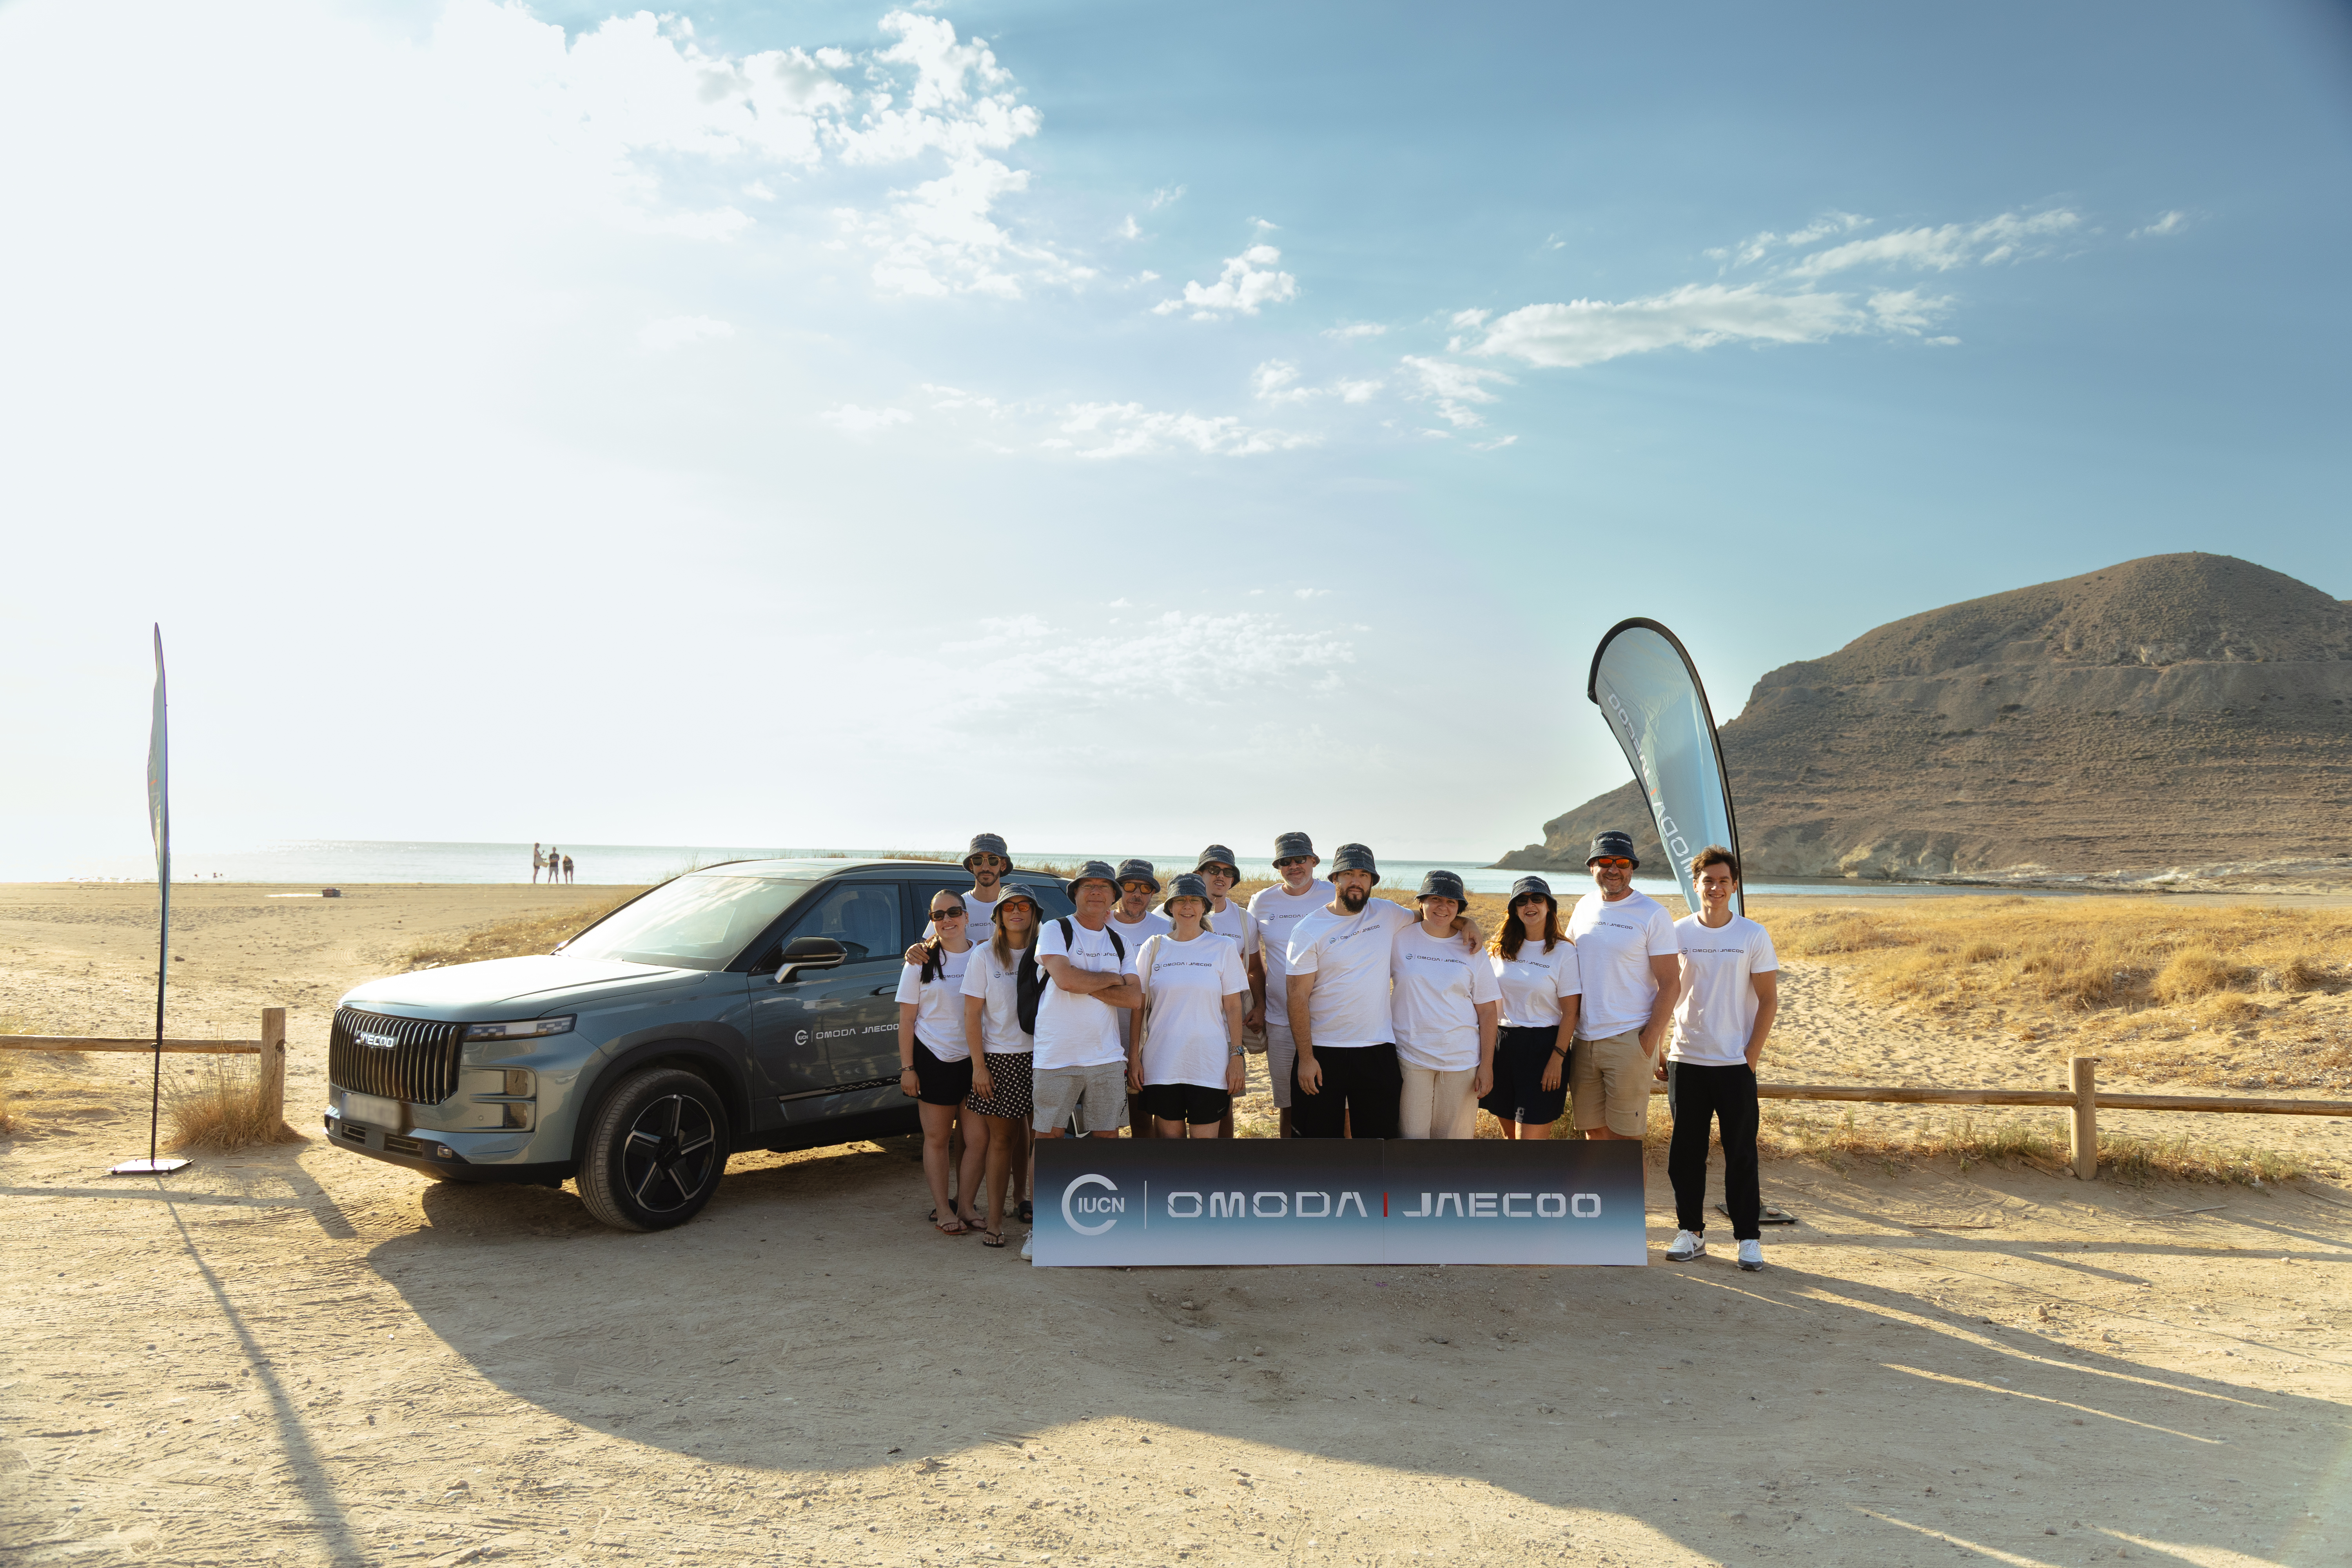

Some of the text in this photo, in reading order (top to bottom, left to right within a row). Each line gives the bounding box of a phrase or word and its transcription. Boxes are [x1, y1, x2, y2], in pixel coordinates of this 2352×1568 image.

[816, 1028, 856, 1039] OMODA
[862, 1024, 899, 1034] JAECOO
[355, 1033, 394, 1047] JAECOO
[1078, 1192, 1601, 1218] IUCN OMODA JAECOO
